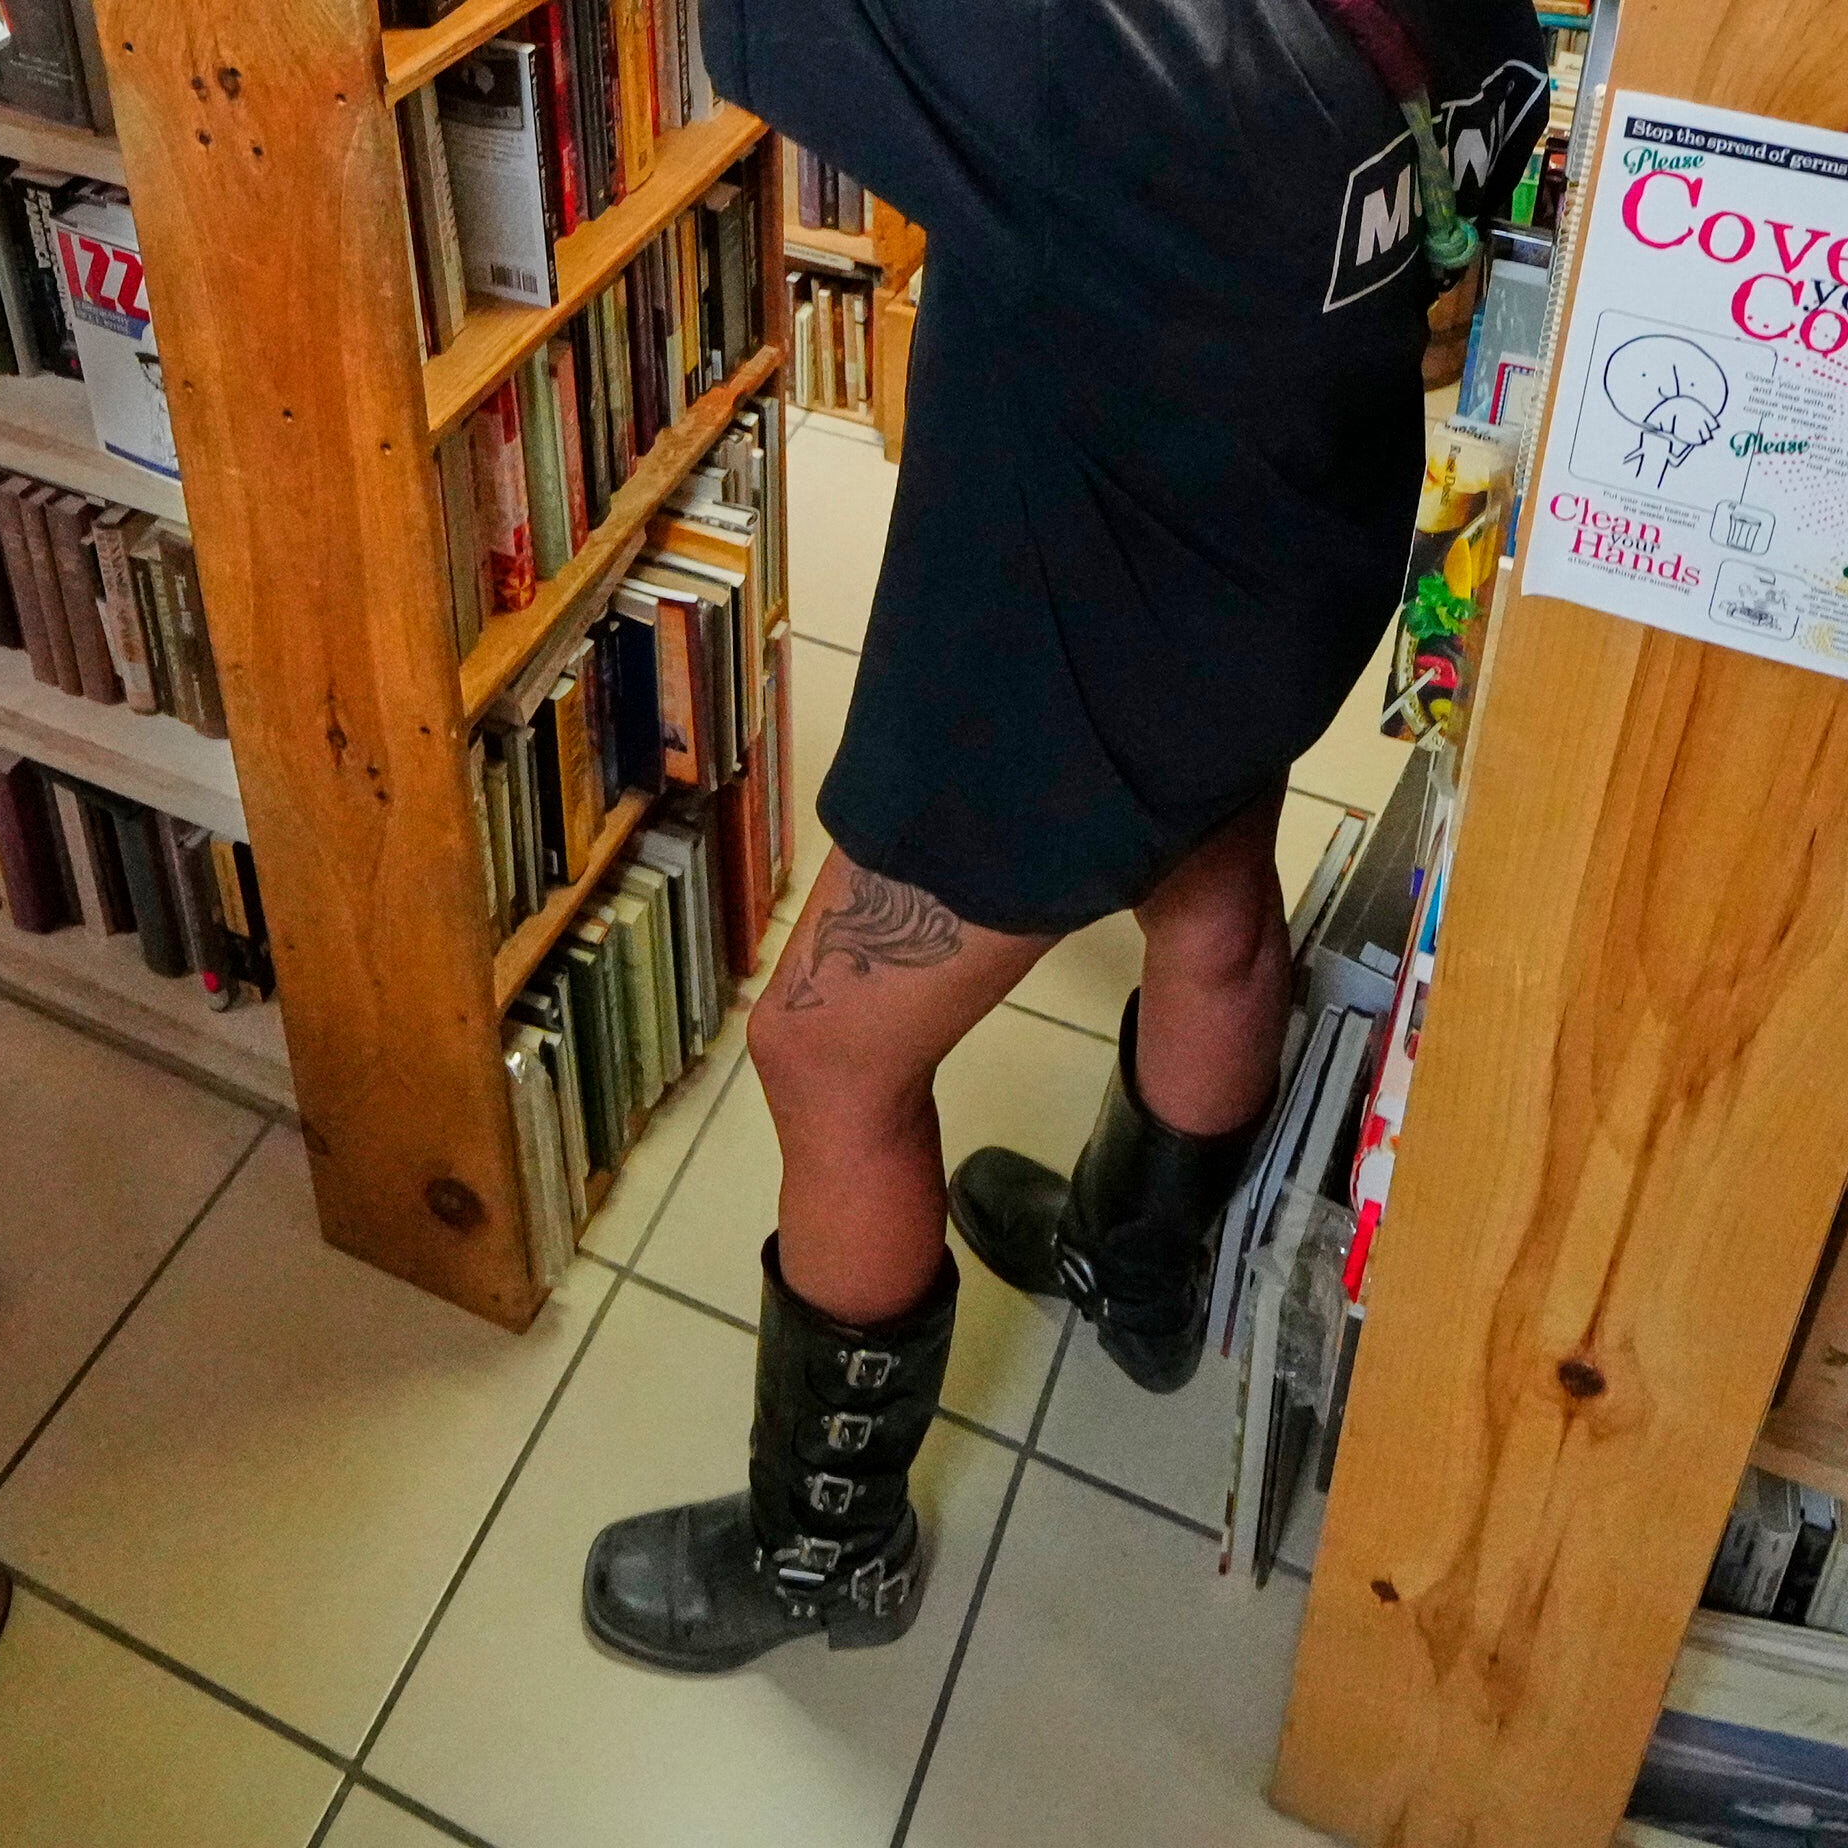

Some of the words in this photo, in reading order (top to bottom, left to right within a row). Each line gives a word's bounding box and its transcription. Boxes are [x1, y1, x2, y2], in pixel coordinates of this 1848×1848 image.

[1623, 145, 1705, 176] Please
[1631, 118, 1674, 143] Stop
[1676, 126, 1706, 148] the
[1705, 135, 1767, 163] spread
[1768, 146, 1790, 164] of
[1789, 152, 1848, 176] germs
[1729, 429, 1811, 458] Please
[1549, 491, 1662, 544] Clean
[1569, 526, 1702, 587] Hands
[1608, 532, 1661, 554] your
